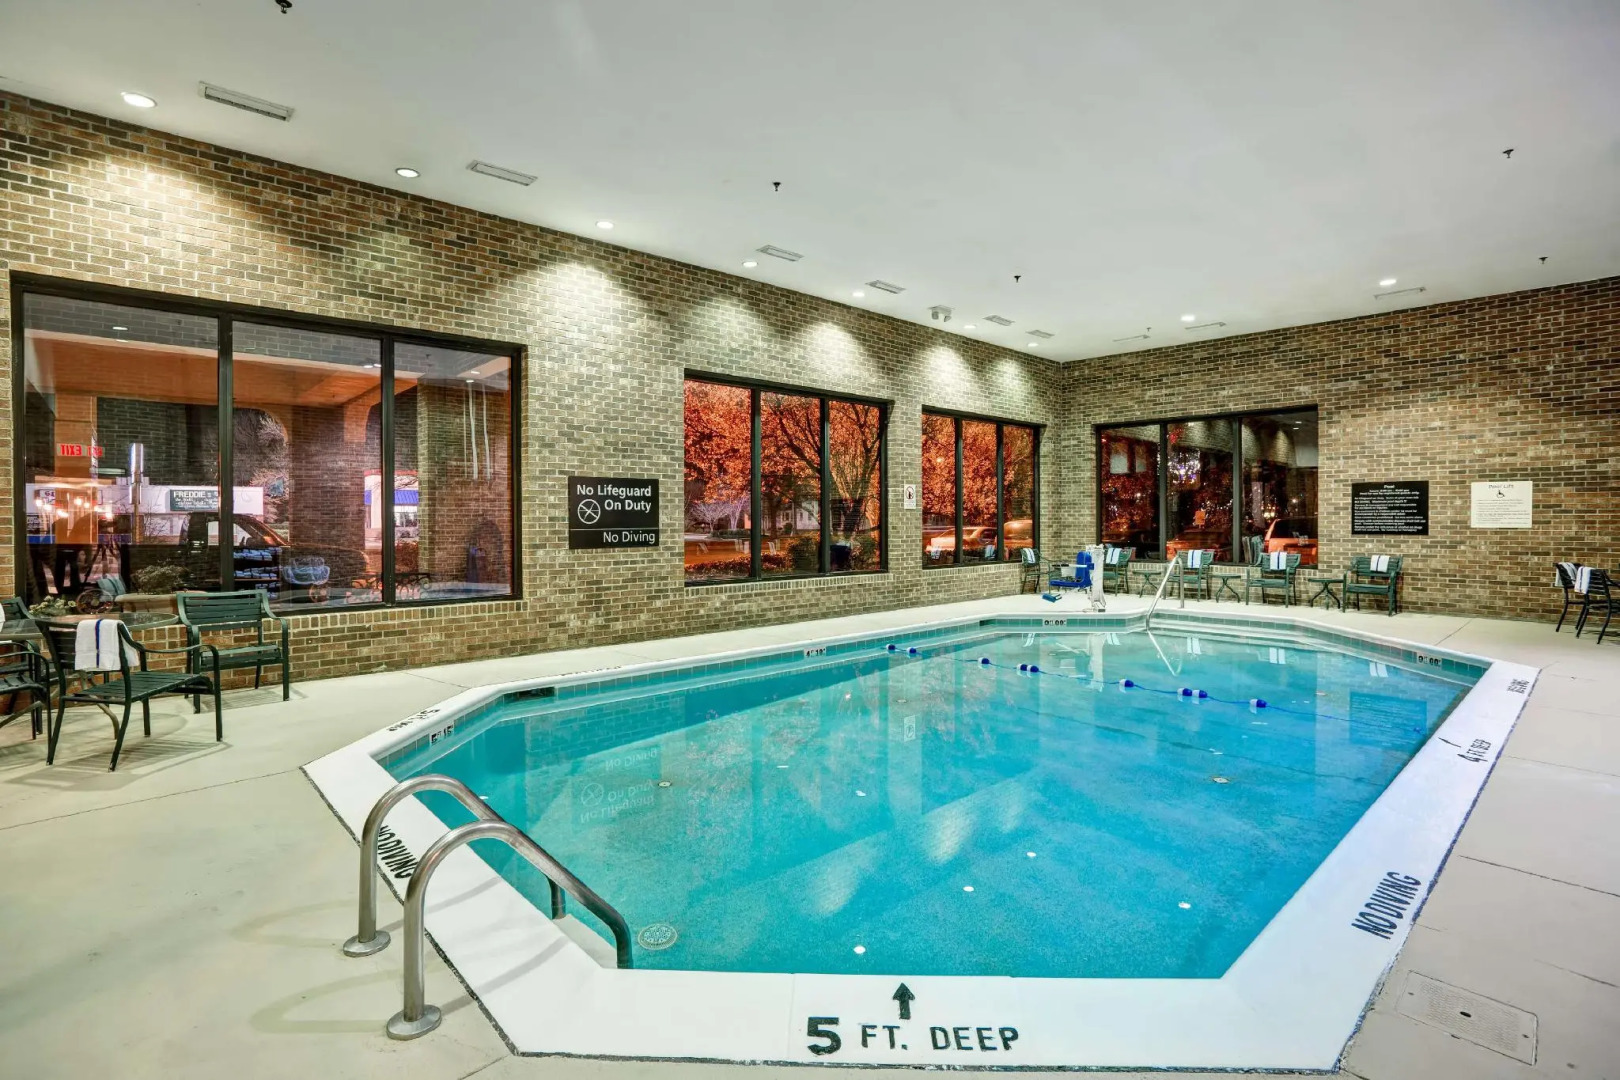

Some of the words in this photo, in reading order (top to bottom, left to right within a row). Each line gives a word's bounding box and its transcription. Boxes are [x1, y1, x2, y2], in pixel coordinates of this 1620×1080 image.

[577, 484, 594, 496] No
[597, 484, 652, 499] Lifeguard
[604, 499, 622, 511] On
[624, 499, 652, 513] Duty
[603, 531, 619, 543] No
[621, 530, 656, 544] Diving
[806, 1016, 842, 1056] 5
[861, 1024, 908, 1050] FT.
[929, 1026, 1019, 1051] DEEP
